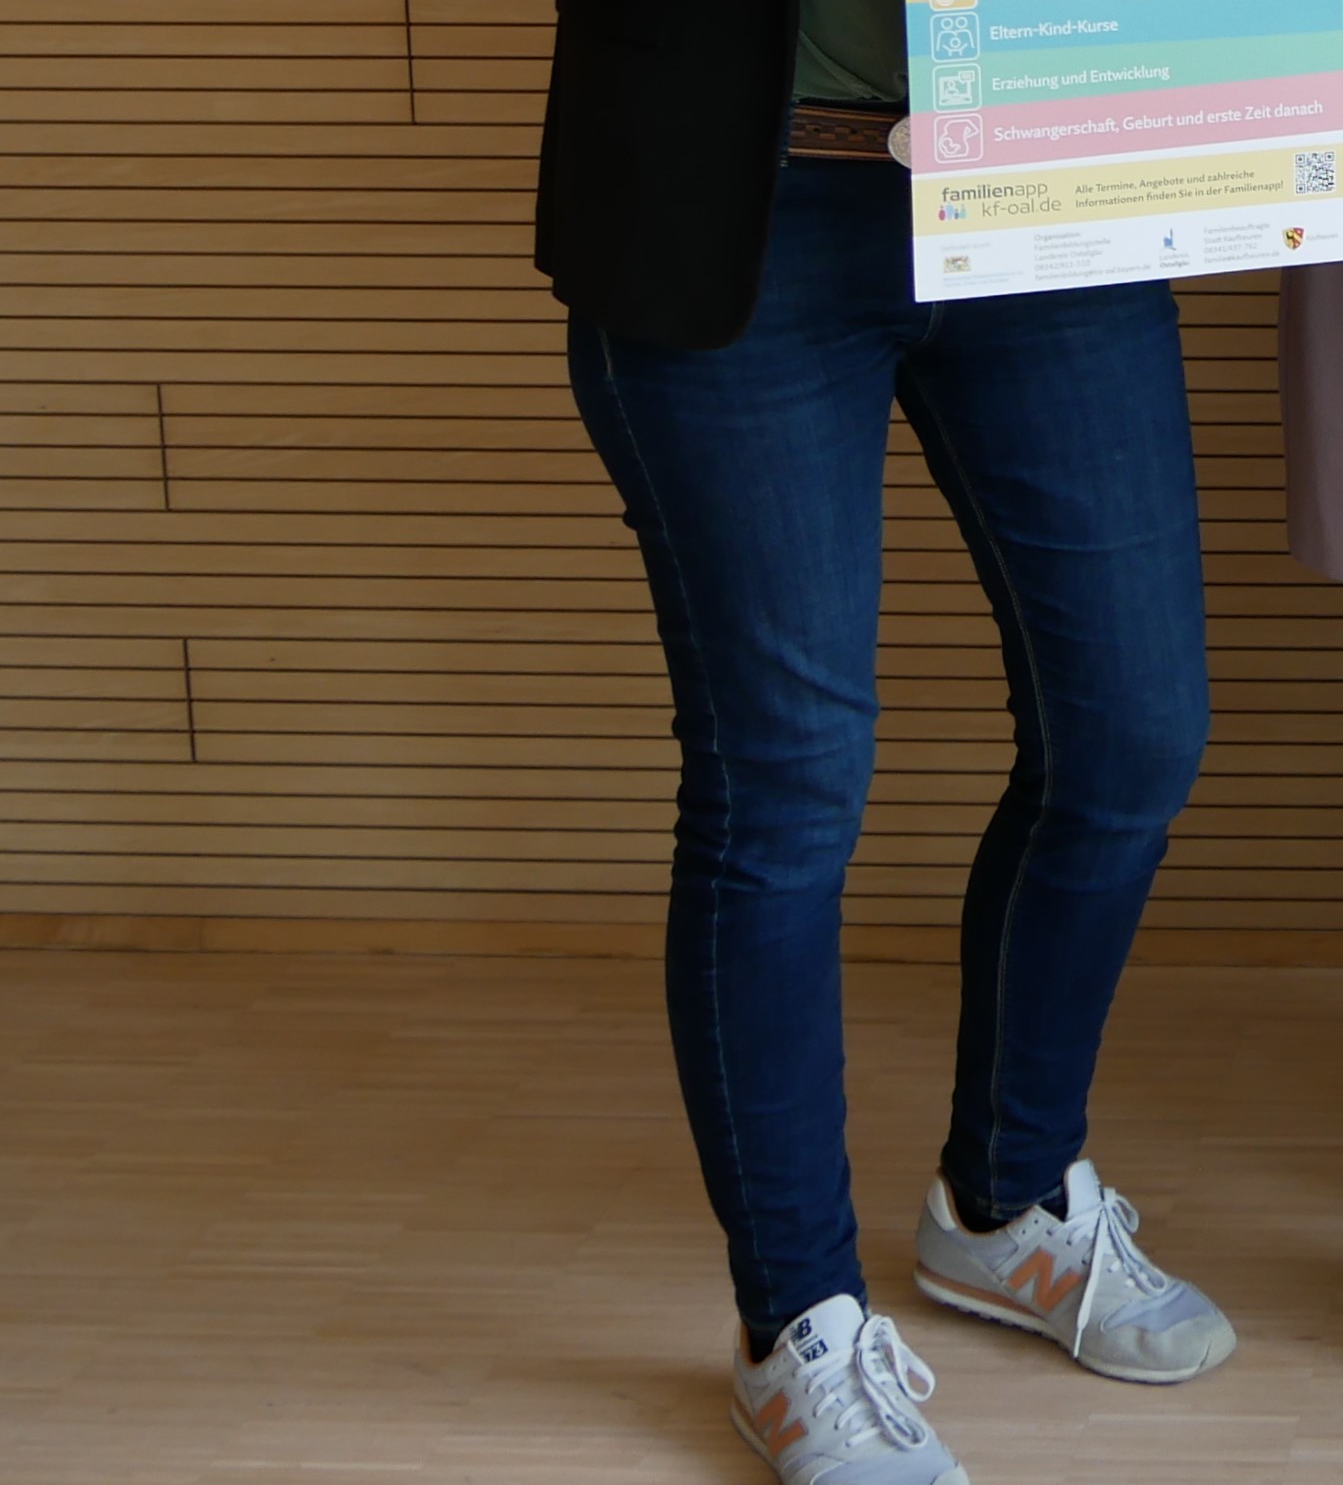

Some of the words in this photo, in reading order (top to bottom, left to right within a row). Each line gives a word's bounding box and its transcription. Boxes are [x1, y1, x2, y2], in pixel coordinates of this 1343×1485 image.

[990, 17, 1119, 41] Eltern-Kind-Kurse
[992, 71, 1059, 93] Erziehung
[1061, 69, 1087, 86] und
[1089, 63, 1170, 84] Entwicklung
[994, 116, 1120, 144] Schwangerschaft,
[1122, 112, 1174, 131] Geburt
[1176, 110, 1203, 126] und
[1206, 106, 1242, 123] erste
[1245, 103, 1271, 120] Zeit
[1274, 99, 1323, 117] danach
[942, 182, 1048, 203] familienapp
[1075, 183, 1094, 195] Alle
[1096, 180, 1137, 194] Termine,
[1139, 176, 1184, 190] Angebote
[1187, 173, 1205, 185] und
[1207, 169, 1255, 183] zahlreiche
[1075, 192, 1144, 208] Informationen
[1147, 189, 1176, 202] finden
[1224, 180, 1284, 195] Familienapp!
[982, 197, 1062, 218] kf-oal.de
[1006, 1247, 1081, 1311] N
